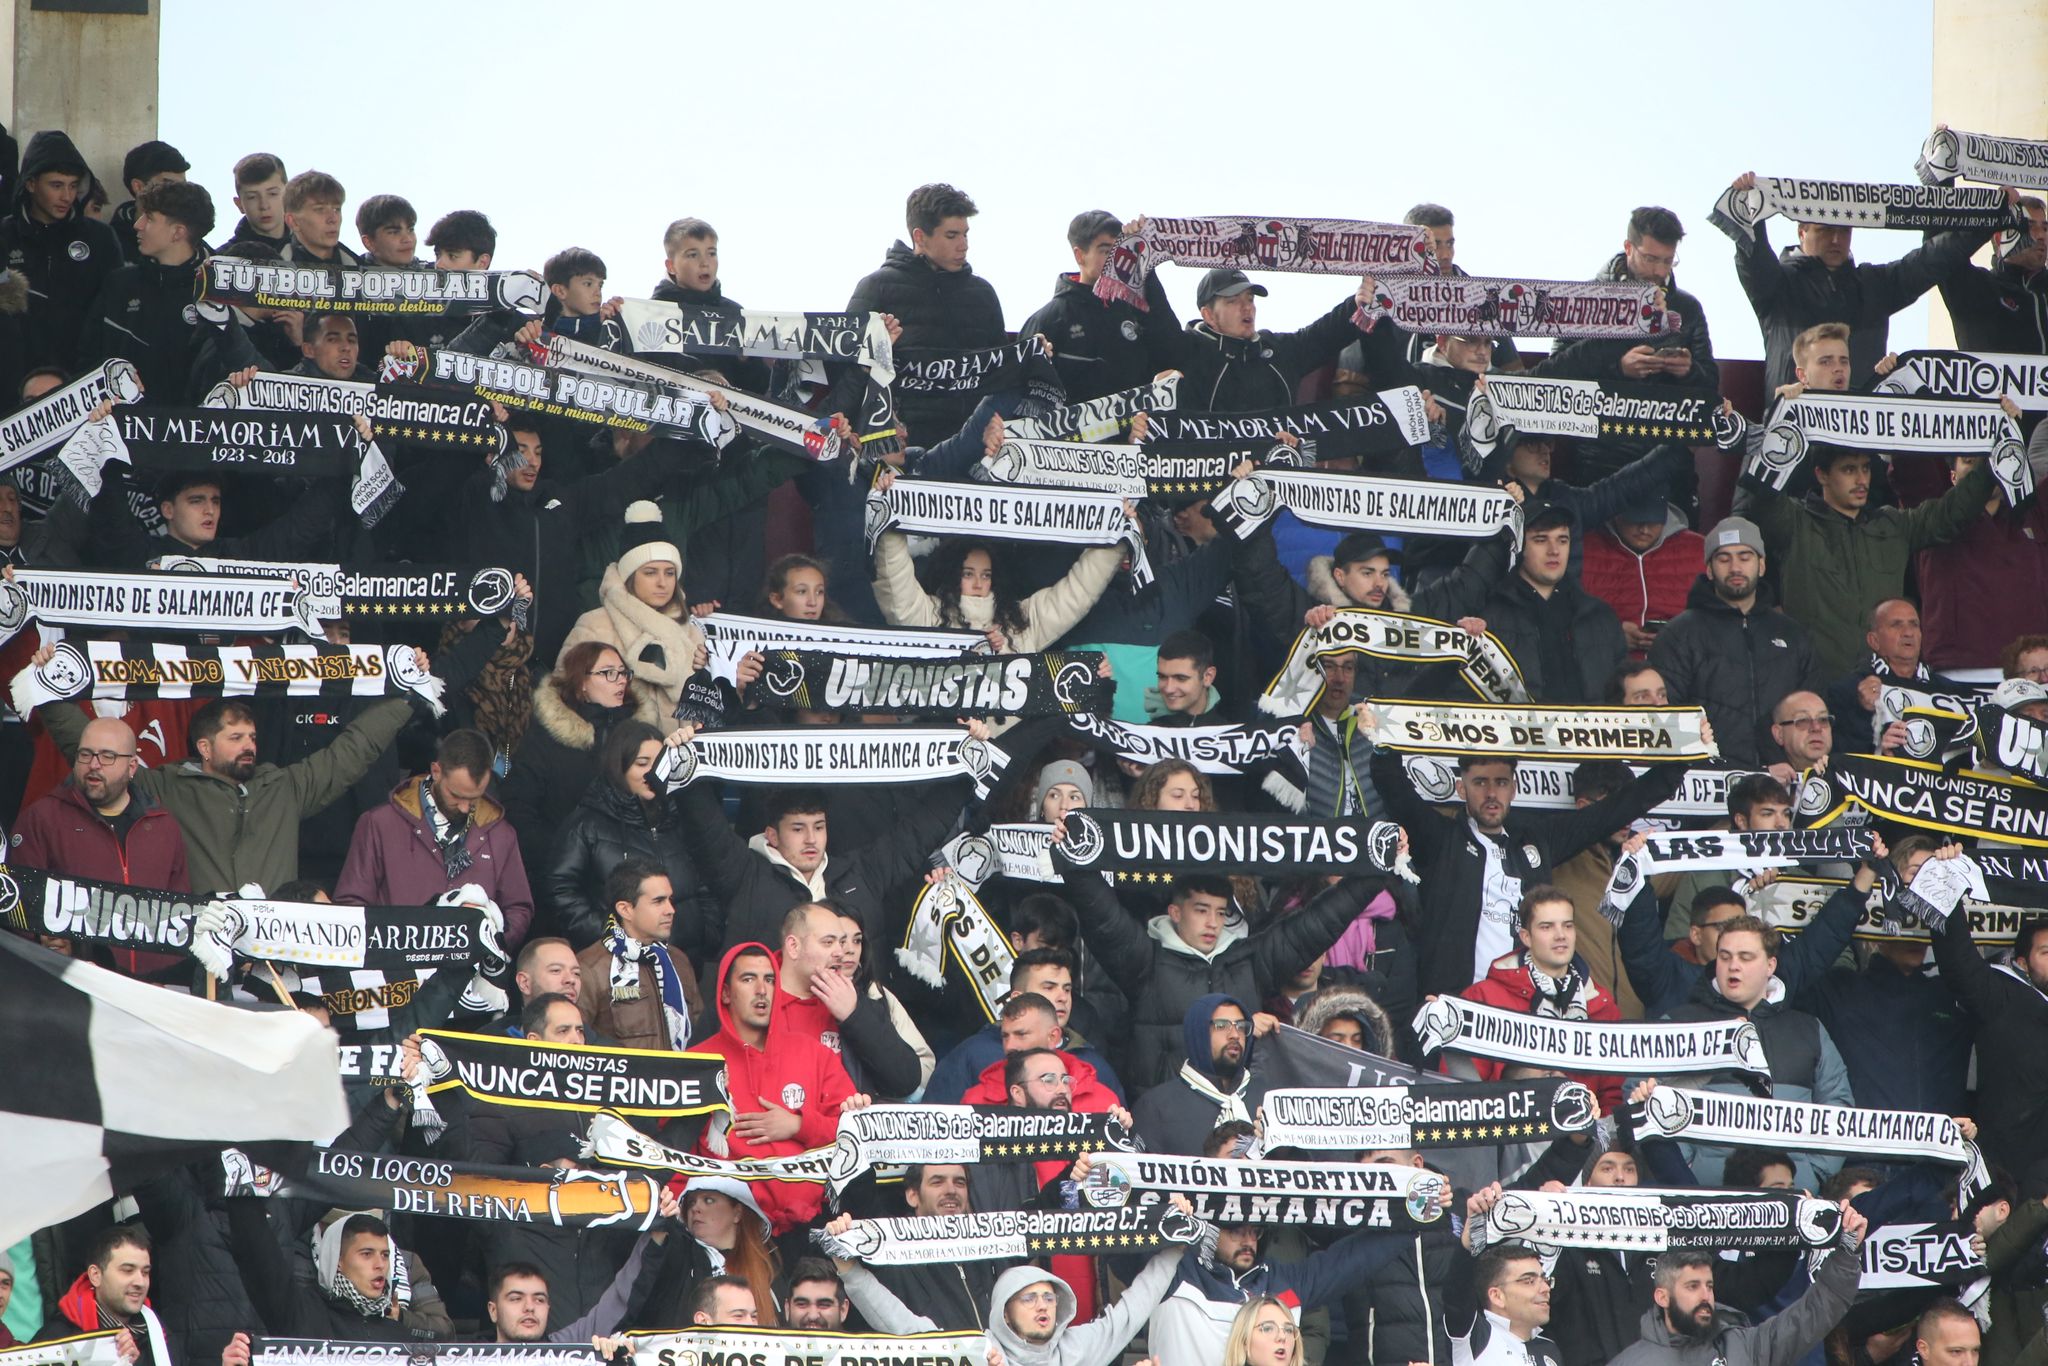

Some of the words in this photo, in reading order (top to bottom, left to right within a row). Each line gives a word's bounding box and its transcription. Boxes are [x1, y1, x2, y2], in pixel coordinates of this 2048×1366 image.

[214, 259, 335, 298] FÚTBOL
[342, 270, 489, 300] POPULAR
[255, 292, 309, 309] Nacemos
[314, 298, 330, 310] de
[333, 301, 352, 311] un
[354, 300, 396, 313] mismo
[399, 298, 445, 314] destino
[247, 379, 344, 415] UNIONISTAS
[365, 391, 461, 425] Salamanca
[435, 350, 550, 400] FÚTBOL
[556, 374, 695, 429] POPULAR
[1489, 381, 1572, 414] UNIONISTAS
[1572, 391, 1592, 415] de
[1592, 390, 1678, 420] Salamanca
[2, 391, 82, 453] SALAMANCA
[474, 384, 532, 409] Nacemos
[546, 404, 563, 416] un
[564, 407, 605, 424] mismo
[607, 414, 649, 433] destino
[1330, 402, 1388, 430] VDS
[1876, 410, 1895, 438] DE
[1901, 412, 1998, 440] SALAMANCA
[211, 447, 245, 462] 1923
[262, 449, 296, 465] 2013
[1029, 443, 1119, 477] UNIONISTAS
[1120, 456, 1138, 478] de
[1137, 452, 1226, 479] Salamanca
[890, 488, 982, 522] UNIONISTAS
[990, 498, 1008, 525] DE
[1014, 500, 1103, 531] SALAMANCA
[1278, 480, 1361, 515] UNIONISTAS
[1367, 491, 1384, 517] DE
[1390, 494, 1476, 523] SALAMANCA
[1483, 498, 1501, 524] CF
[31, 582, 126, 614] UNIONISTAS
[132, 587, 152, 614] DE
[158, 588, 254, 618] SALAMANCA
[260, 591, 281, 618] CF
[313, 570, 334, 597] de
[333, 570, 428, 598] Salamanca
[430, 571, 460, 598] C.F.
[1384, 626, 1420, 649] DE
[92, 659, 223, 684] KOMANDO
[825, 658, 1032, 711] UNIONISTAS
[1510, 726, 1546, 746] DE
[708, 742, 801, 770] UNIONISTAS
[805, 743, 823, 769] DE
[829, 742, 920, 770] SALAMANCA
[927, 741, 946, 768] CF
[1905, 769, 2013, 803] UNIONISTAS
[1943, 796, 1987, 827] SE
[1112, 822, 1358, 864] UNIONISTAS
[1645, 836, 1724, 863] LAS
[255, 915, 361, 949] KOMANDO
[368, 924, 471, 950] ARRIBES
[405, 953, 430, 962] DESDE
[450, 952, 471, 961] USCF
[970, 943, 1003, 986] DE
[1475, 1012, 1567, 1054] UNIONISTAS
[1574, 1030, 1592, 1058] DE
[1599, 1031, 1697, 1059] SALAMANCA
[1703, 1029, 1723, 1055] CF
[529, 1051, 628, 1073] UNIONISTAS
[457, 1060, 560, 1098] NUNCA
[564, 1072, 604, 1100] SE
[609, 1076, 702, 1105] RINDE
[854, 1111, 951, 1141] UNIONISTAS
[951, 1113, 973, 1141] de
[972, 1111, 1066, 1140] Salamanca
[1066, 1111, 1095, 1135] C.F.
[1274, 1096, 1376, 1127] UNIONISTAS
[1377, 1099, 1401, 1126] de
[1401, 1095, 1506, 1125] Salamanca
[1508, 1090, 1540, 1119] C.F.
[1706, 1100, 1804, 1134] UNIONISTAS
[1809, 1107, 1832, 1135] DE
[1836, 1110, 1934, 1143] SALAMANCA
[318, 1151, 363, 1178] LOS
[371, 1157, 453, 1187] LOCOS
[736, 1162, 773, 1173] DE
[1138, 1159, 1228, 1187] UNIÓN
[1239, 1167, 1398, 1192] DEPORTIVA
[392, 1186, 440, 1215] DEL
[888, 1213, 993, 1241] UNIONISTAS
[993, 1212, 1016, 1237] de
[1016, 1210, 1117, 1235] Salamanca
[1119, 1206, 1149, 1230] C.F.
[675, 1337, 781, 1350] UNIONISTAS
[827, 1343, 927, 1351] SALAMANCA
